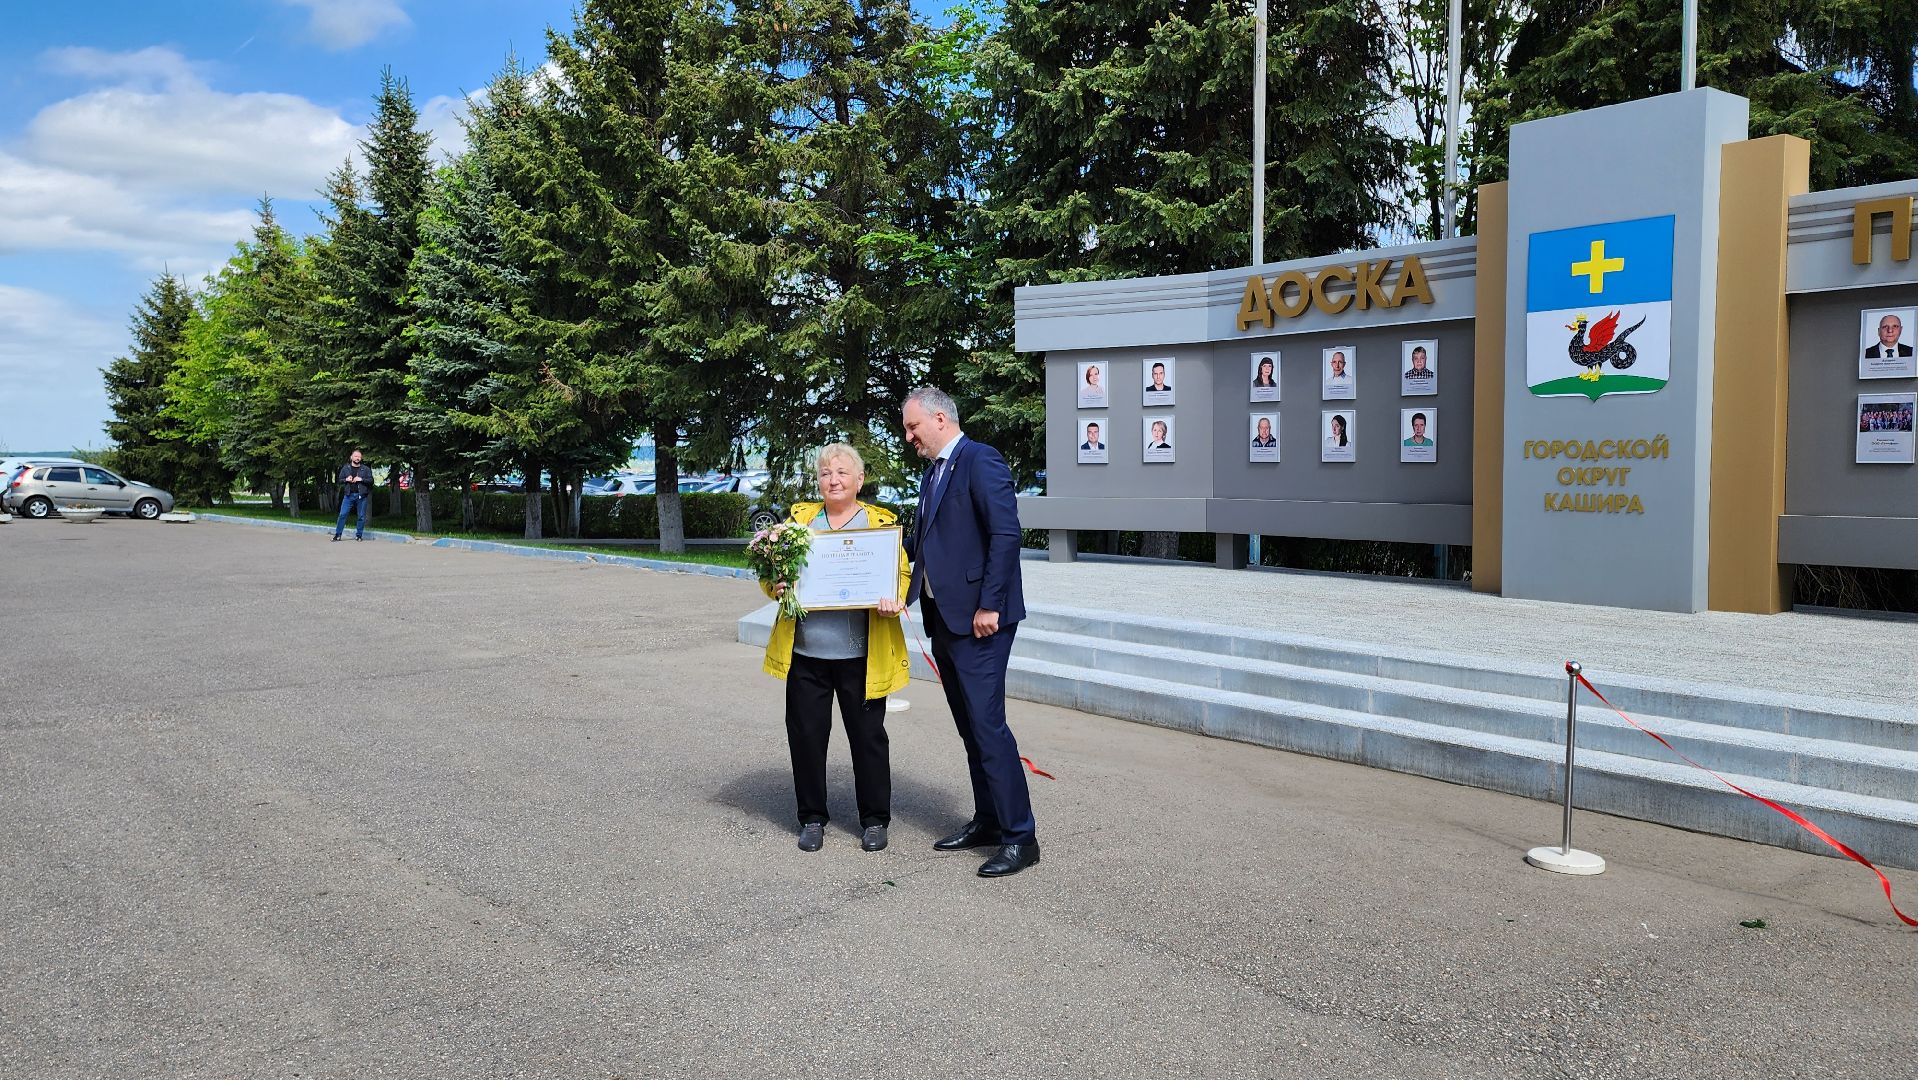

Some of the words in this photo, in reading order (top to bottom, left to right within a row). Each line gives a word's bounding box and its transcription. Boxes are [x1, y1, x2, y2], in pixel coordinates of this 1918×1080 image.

[1237, 256, 1434, 330] ДОСКА
[1524, 434, 1669, 462] ГОРОДСКОЙ
[1558, 467, 1631, 486] ОКРУГ
[1544, 493, 1645, 514] КАШИРА
